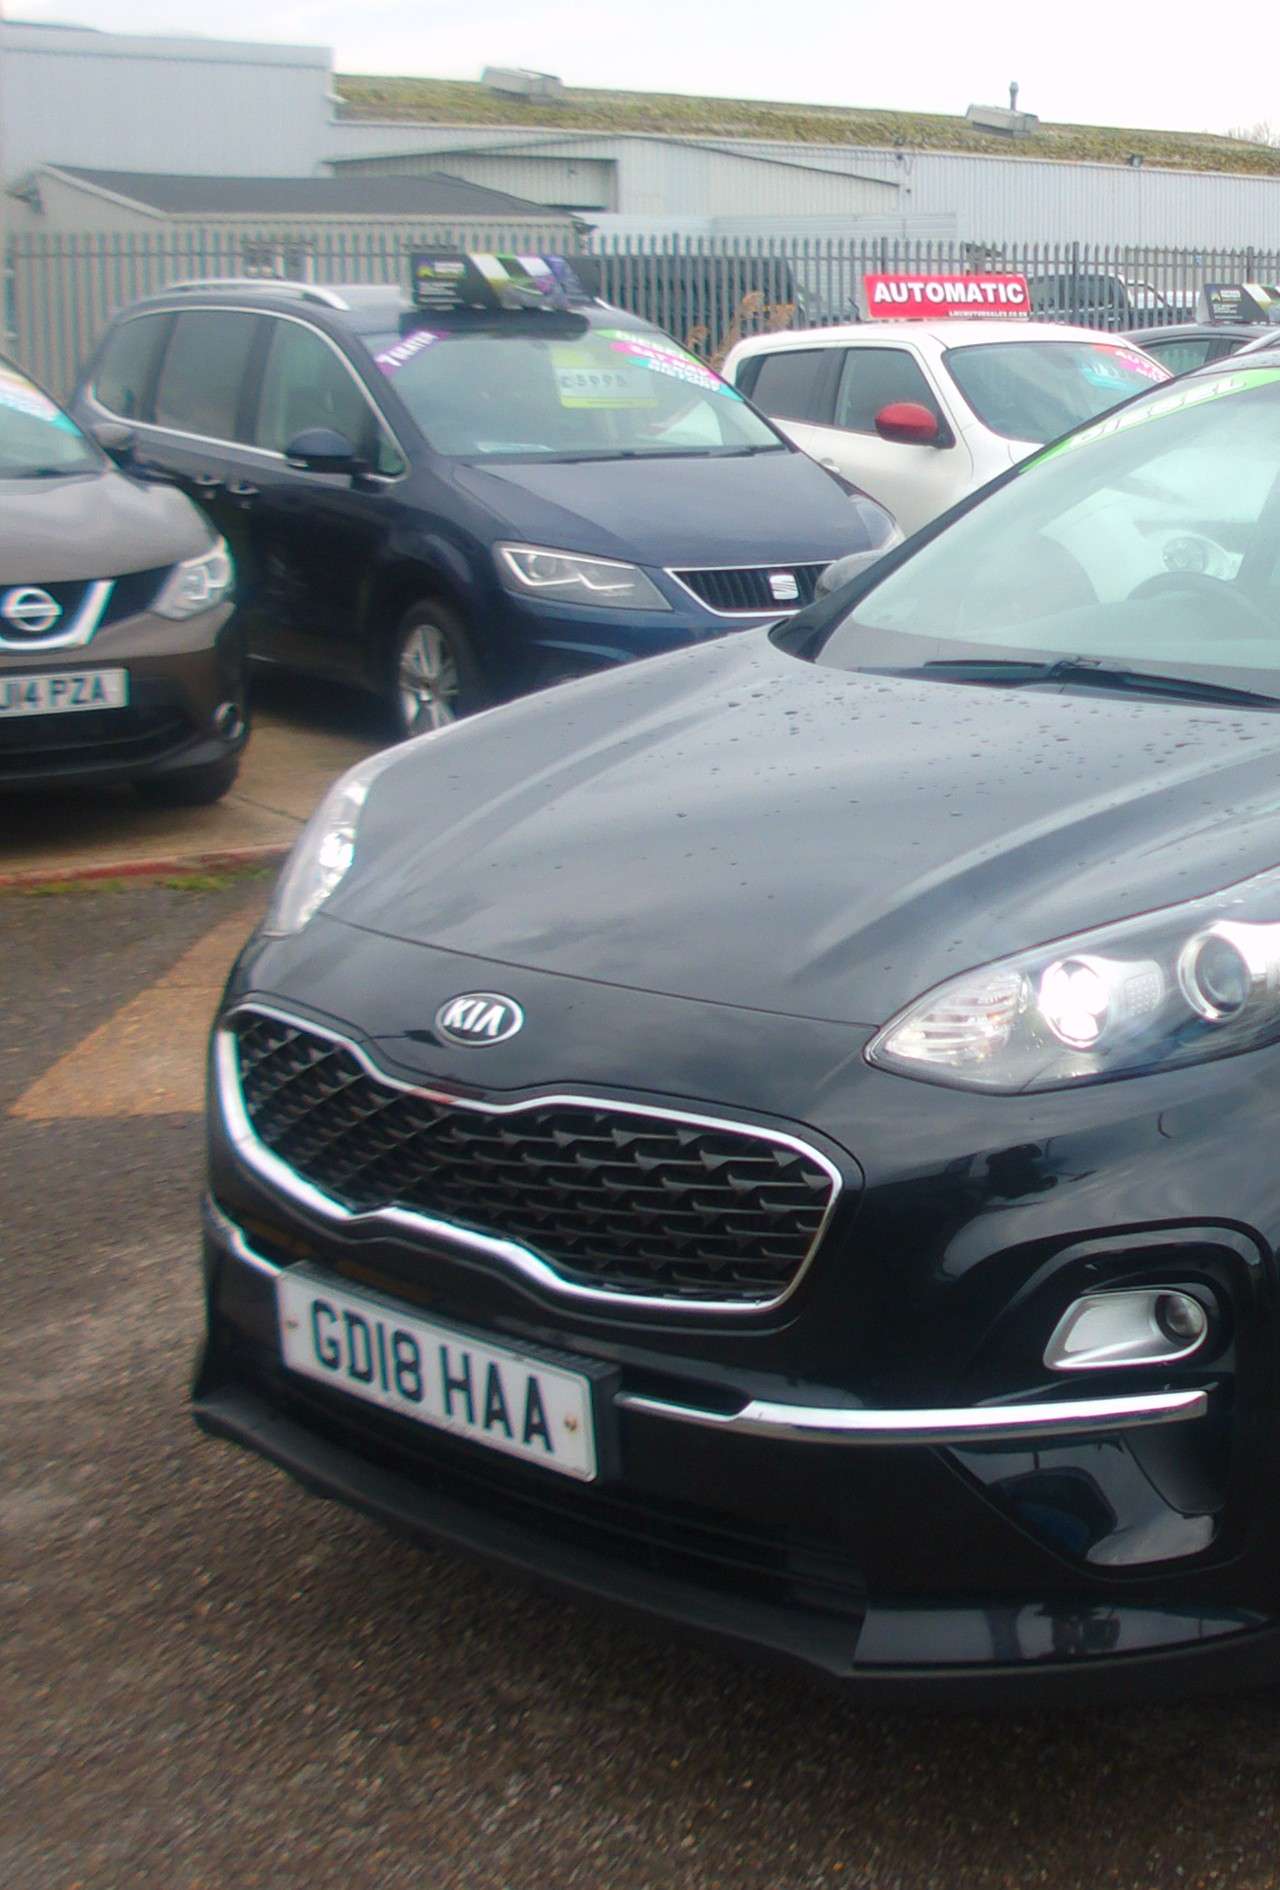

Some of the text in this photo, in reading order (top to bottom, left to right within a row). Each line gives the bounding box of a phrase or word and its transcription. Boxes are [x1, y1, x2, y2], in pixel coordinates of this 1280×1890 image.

[874, 282, 1025, 304] AUTOMATIC
[47, 673, 113, 706] PZA
[443, 999, 506, 1036] KIA
[312, 1298, 554, 1454] GD18 HAA
